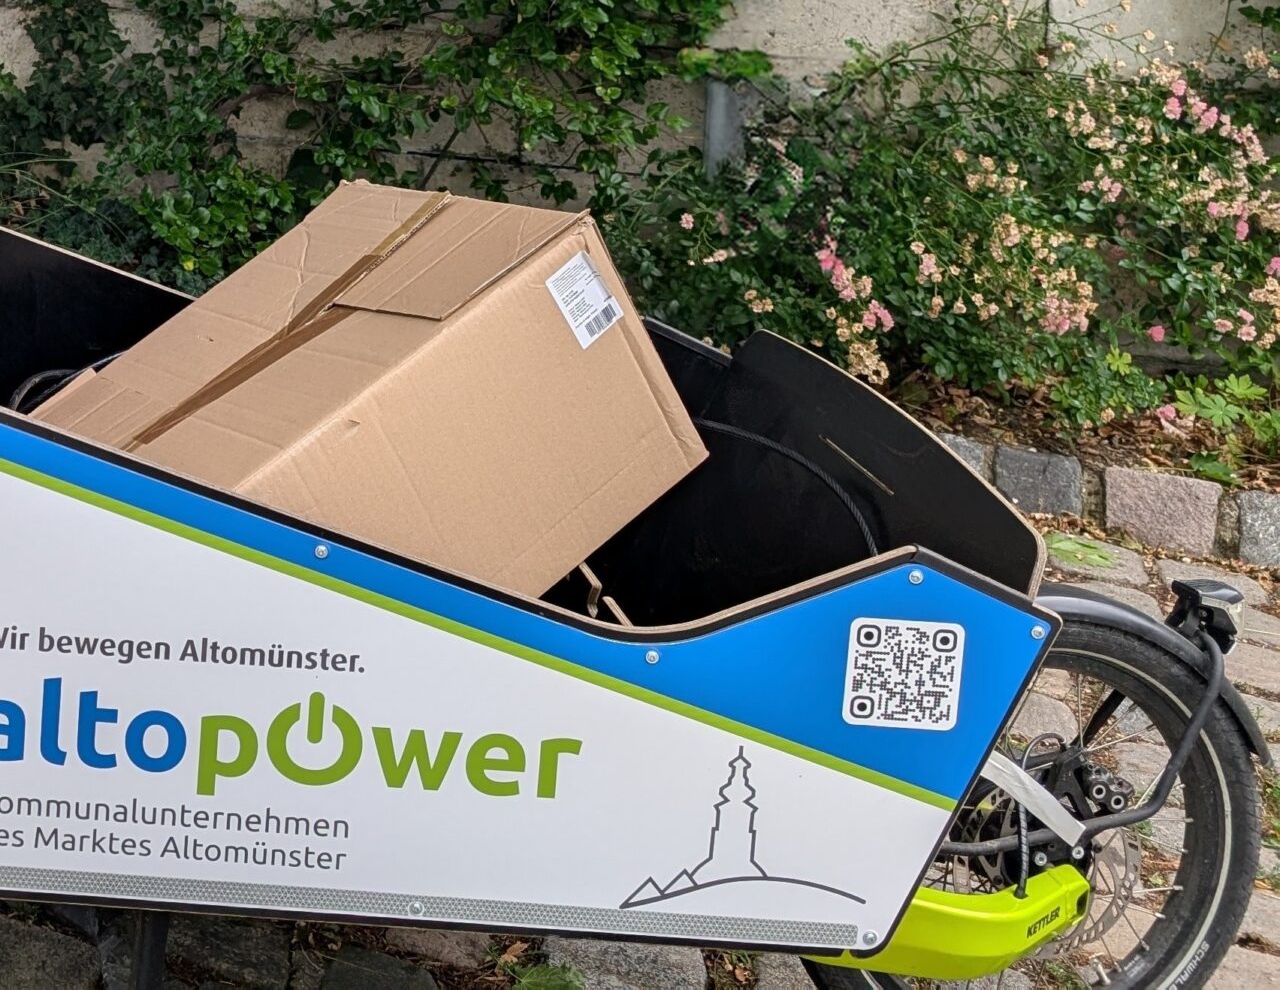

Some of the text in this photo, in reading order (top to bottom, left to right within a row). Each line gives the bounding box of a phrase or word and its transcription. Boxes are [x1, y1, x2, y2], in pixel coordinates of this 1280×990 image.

[38, 626, 171, 664] bewegen
[179, 637, 365, 673] Altomünster.
[34, 826, 152, 857] Marktes
[160, 835, 347, 870] Altomünster
[1026, 906, 1061, 938] KETTLER
